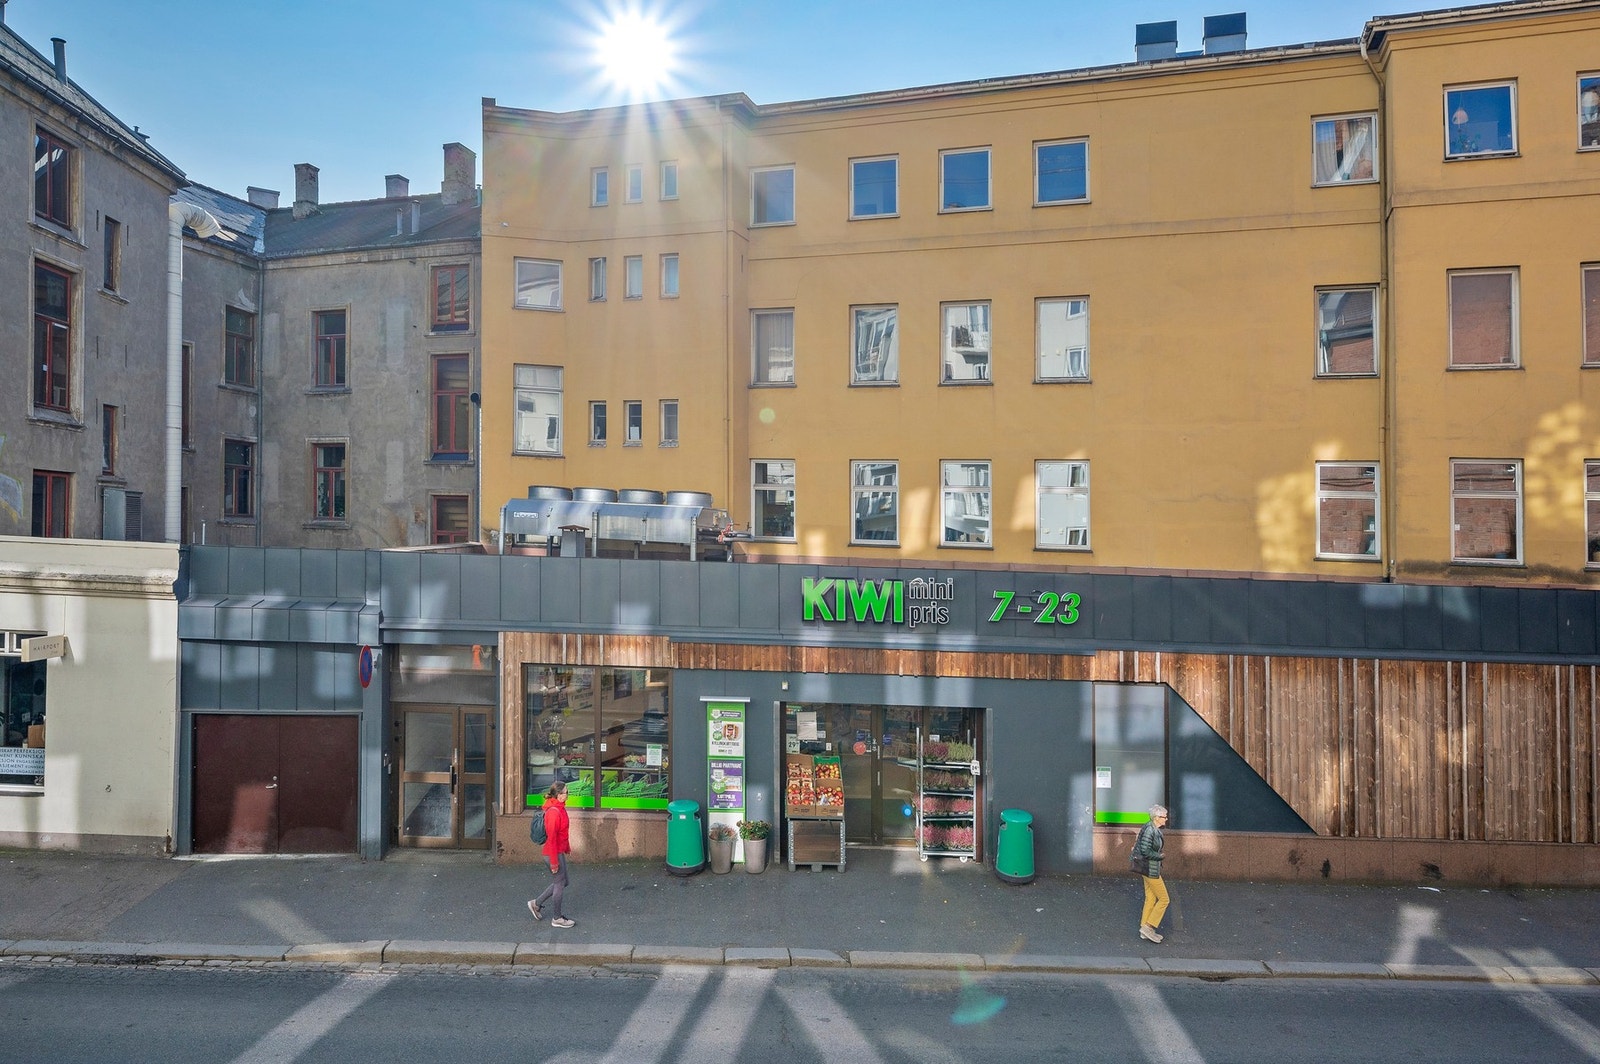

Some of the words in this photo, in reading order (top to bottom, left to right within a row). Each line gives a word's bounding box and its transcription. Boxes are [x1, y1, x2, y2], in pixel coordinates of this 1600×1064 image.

[801, 577, 904, 623] KIWI
[908, 577, 953, 600] mini
[908, 601, 950, 628] pris
